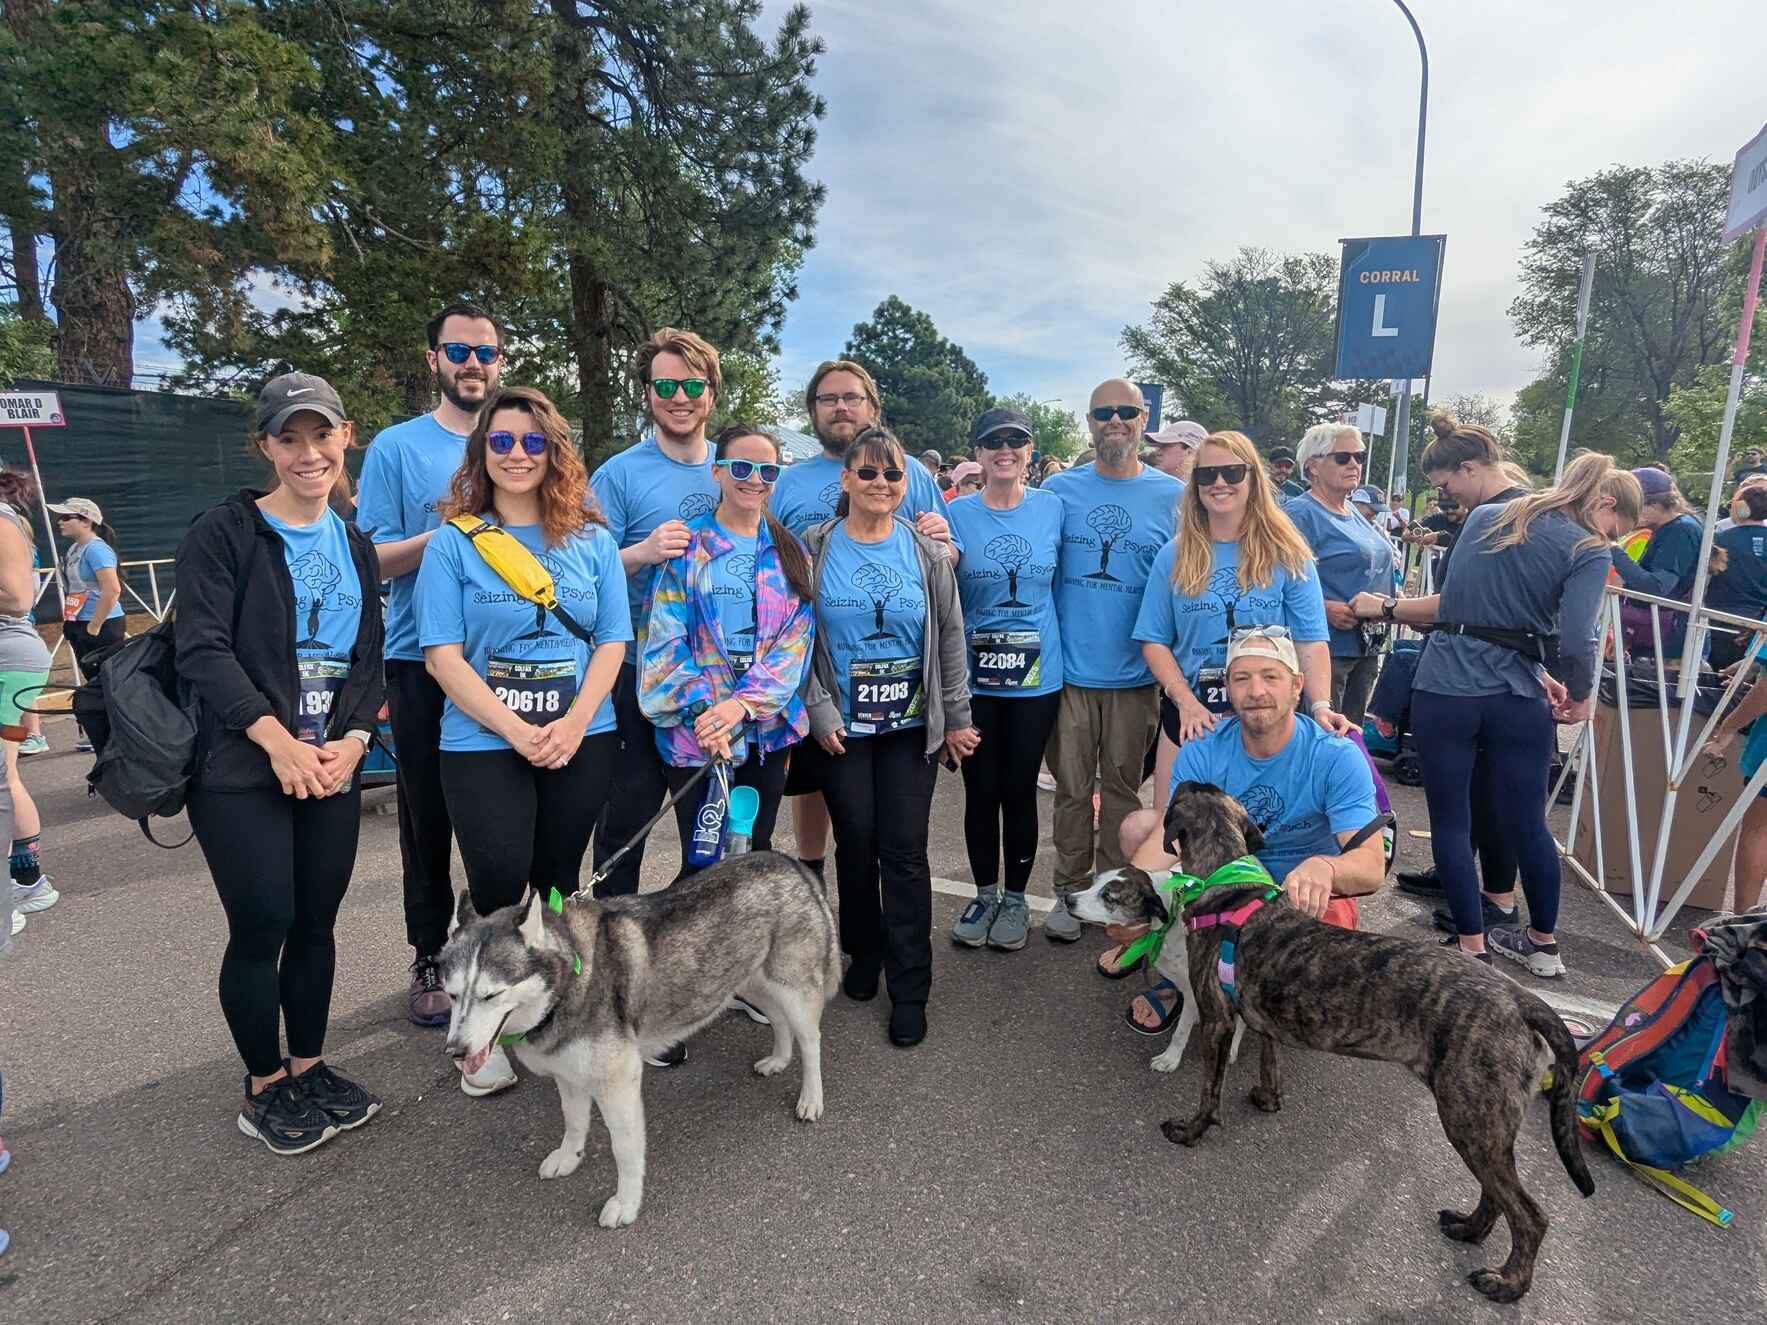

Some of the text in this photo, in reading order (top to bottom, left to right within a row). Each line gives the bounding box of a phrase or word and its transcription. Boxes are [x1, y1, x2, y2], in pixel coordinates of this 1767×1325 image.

[1360, 270, 1420, 284] CORRAL
[1372, 294, 1399, 337] L
[0, 398, 43, 409] OMAR D
[7, 408, 41, 419] BLAIR
[473, 591, 528, 606] Seizing
[825, 596, 868, 610] Seizing
[979, 652, 1026, 669] 22084
[495, 686, 560, 712] 20618
[858, 681, 909, 703] 21203
